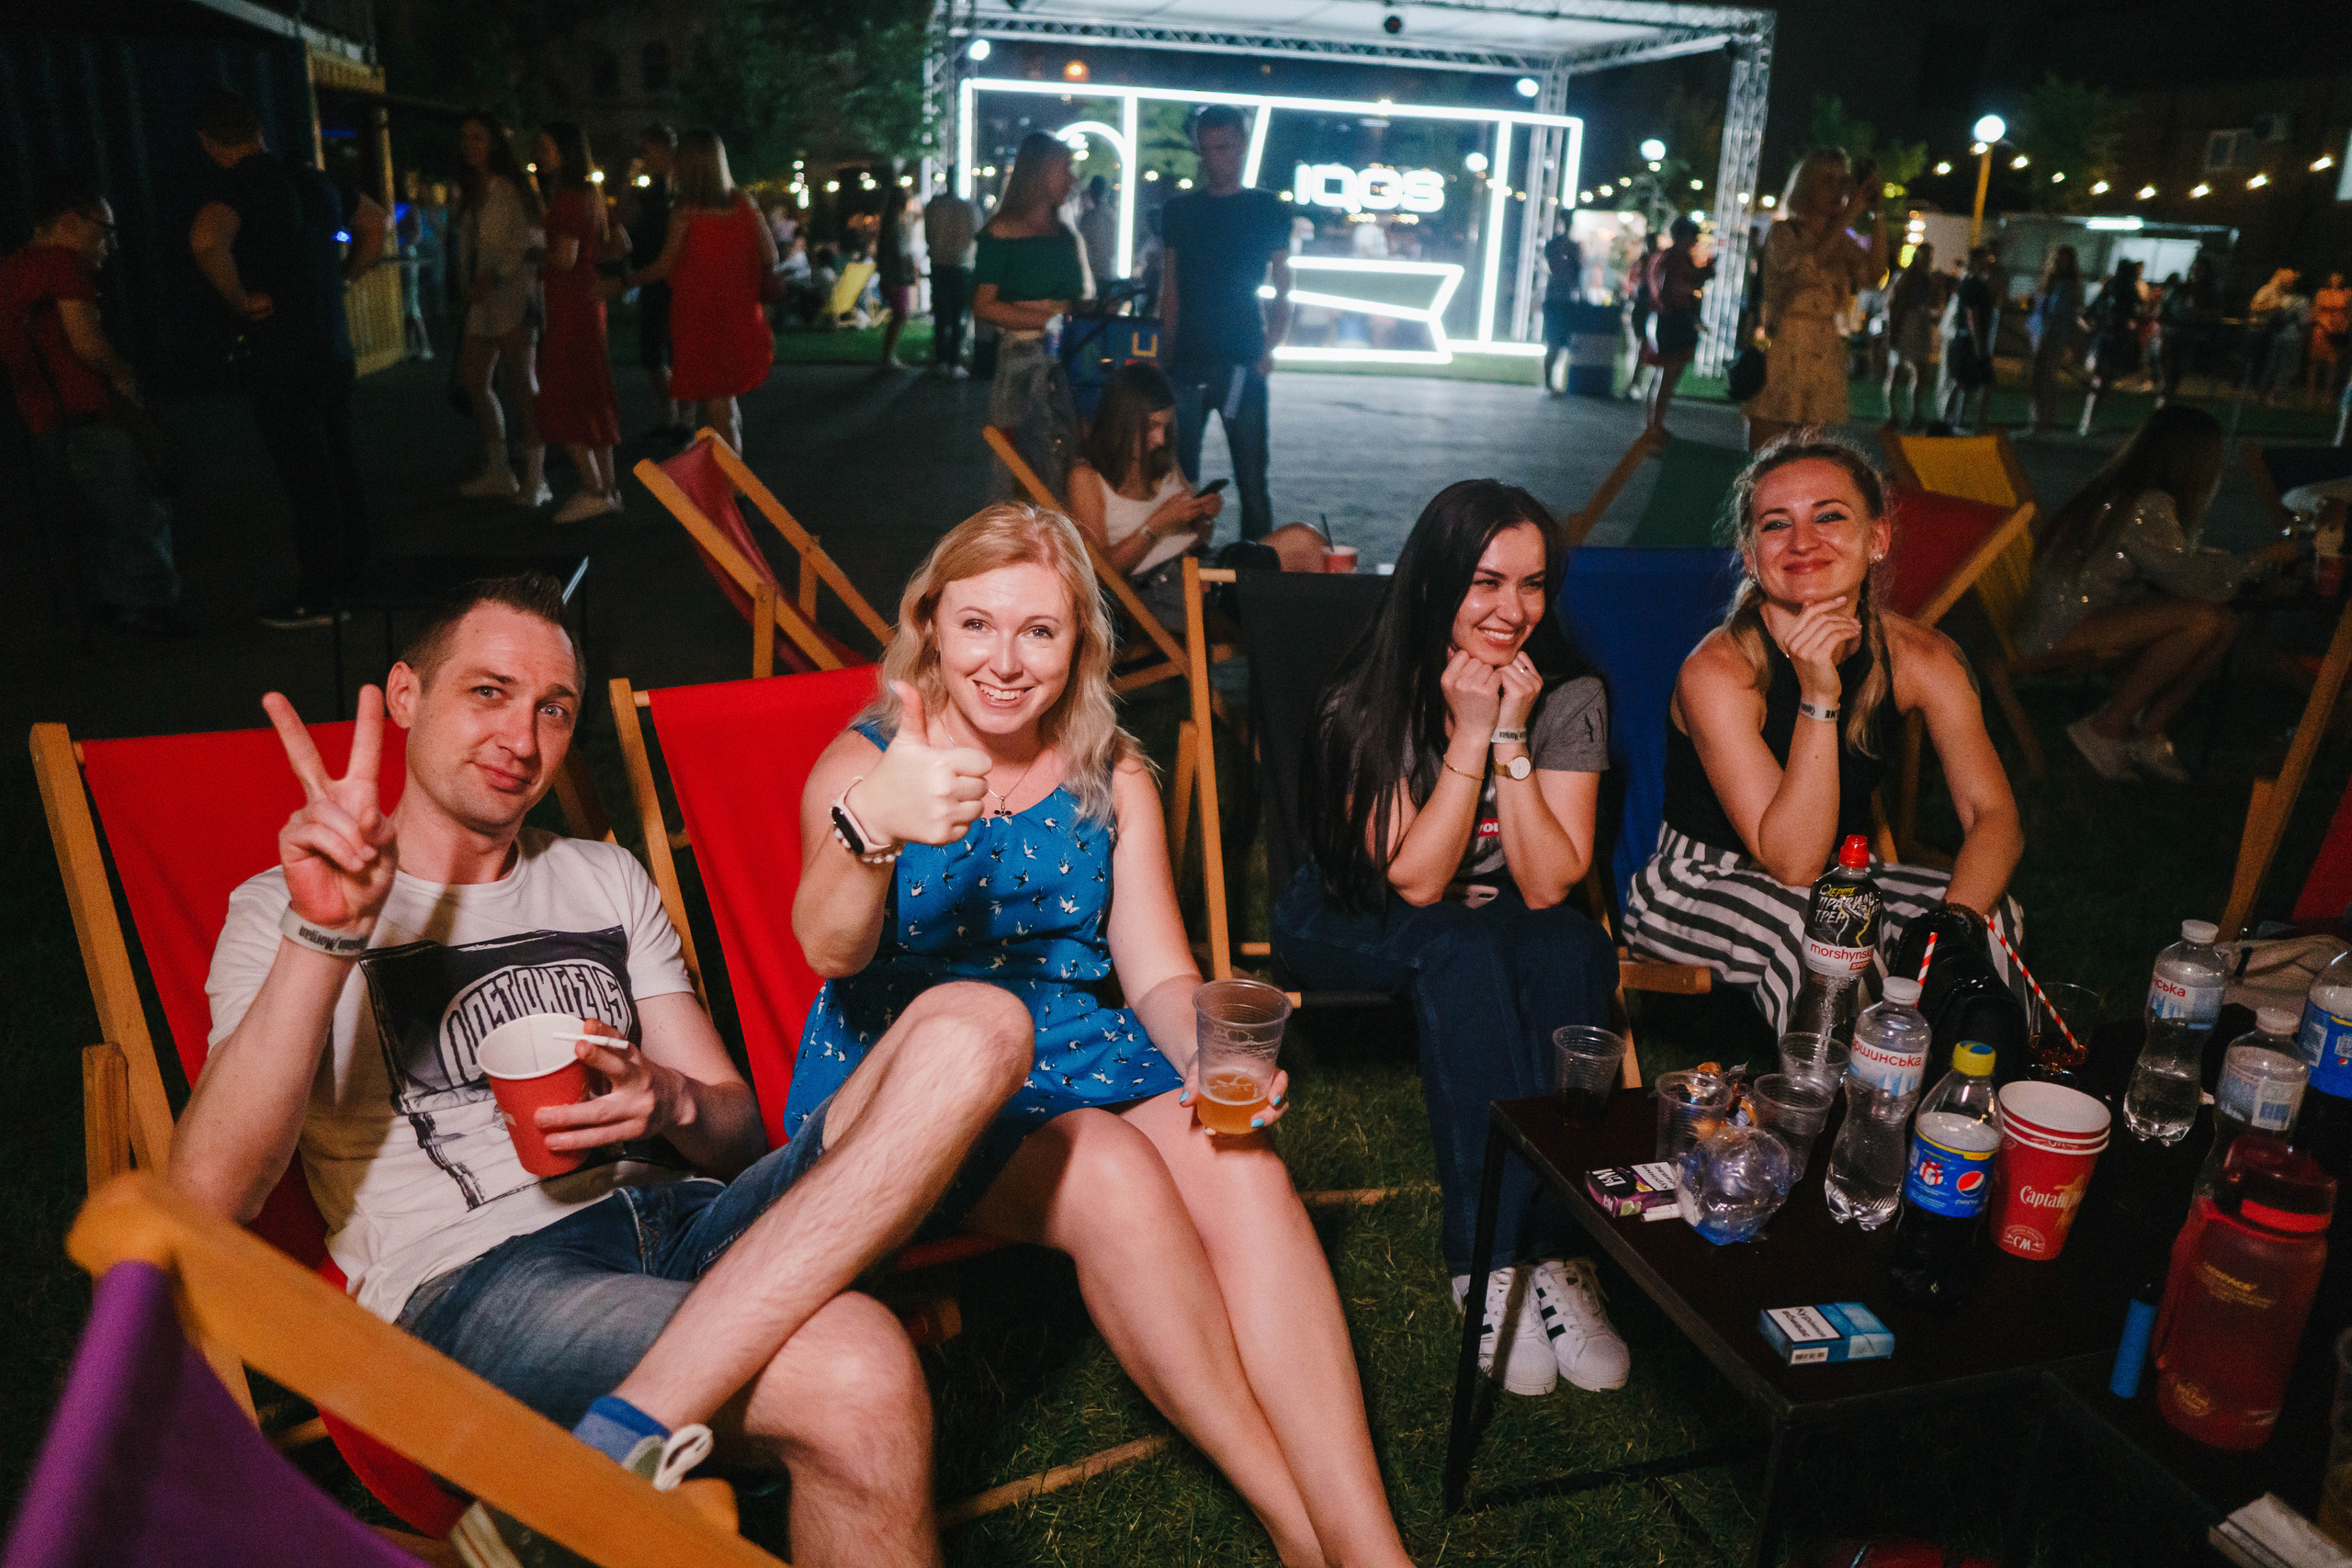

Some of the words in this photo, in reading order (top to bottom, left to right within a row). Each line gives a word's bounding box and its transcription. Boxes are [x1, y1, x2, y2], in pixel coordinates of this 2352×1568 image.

[1294, 156, 1445, 214] IQOS
[1852, 1039, 1922, 1067] ршинська
[1592, 1168, 1627, 1187] L&M
